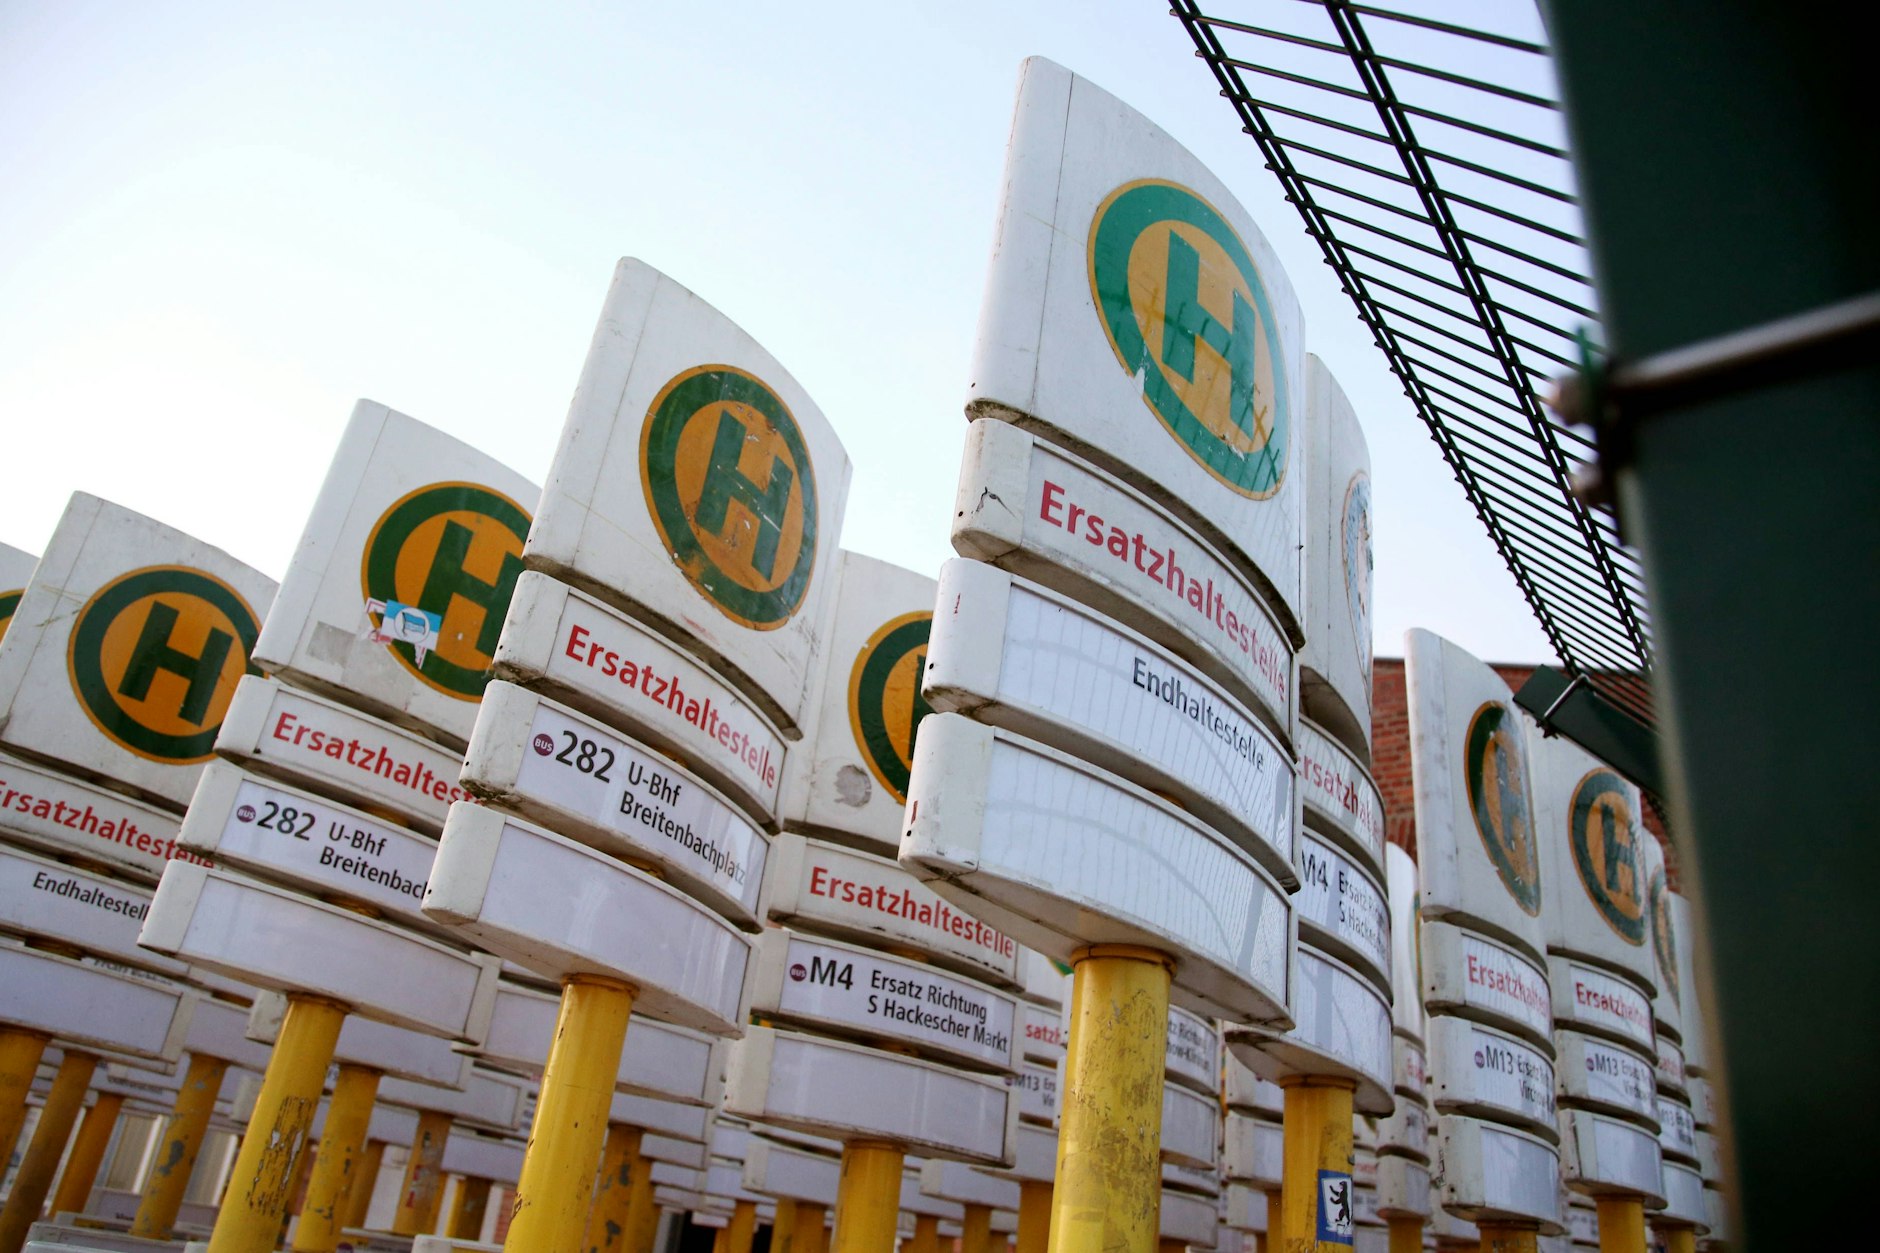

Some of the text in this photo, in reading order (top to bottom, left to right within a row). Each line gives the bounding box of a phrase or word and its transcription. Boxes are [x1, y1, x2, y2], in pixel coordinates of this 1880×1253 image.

[1040, 480, 1286, 702] Ersatzhaltestelle
[565, 624, 775, 790] Ersatzhaltestelle
[1133, 656, 1264, 772] Endhaltestelle
[273, 712, 486, 807] Ersatzhaltes
[555, 730, 616, 784] 282
[628, 760, 682, 807] U-Bhf
[257, 801, 316, 841] 282
[329, 821, 389, 857] U-Bhf
[620, 790, 747, 886] Breitenbachplatz
[33, 871, 150, 922] Endhaltestell
[810, 866, 1014, 959] Ersatzhaltestelle
[810, 956, 853, 990] M4
[871, 969, 988, 1025] Ersatz Richtung
[867, 994, 1009, 1053] S Hackescher Markt
[1015, 1073, 1040, 1091] M13
[1486, 1045, 1514, 1075] M13
[1595, 1053, 1619, 1077] M13
